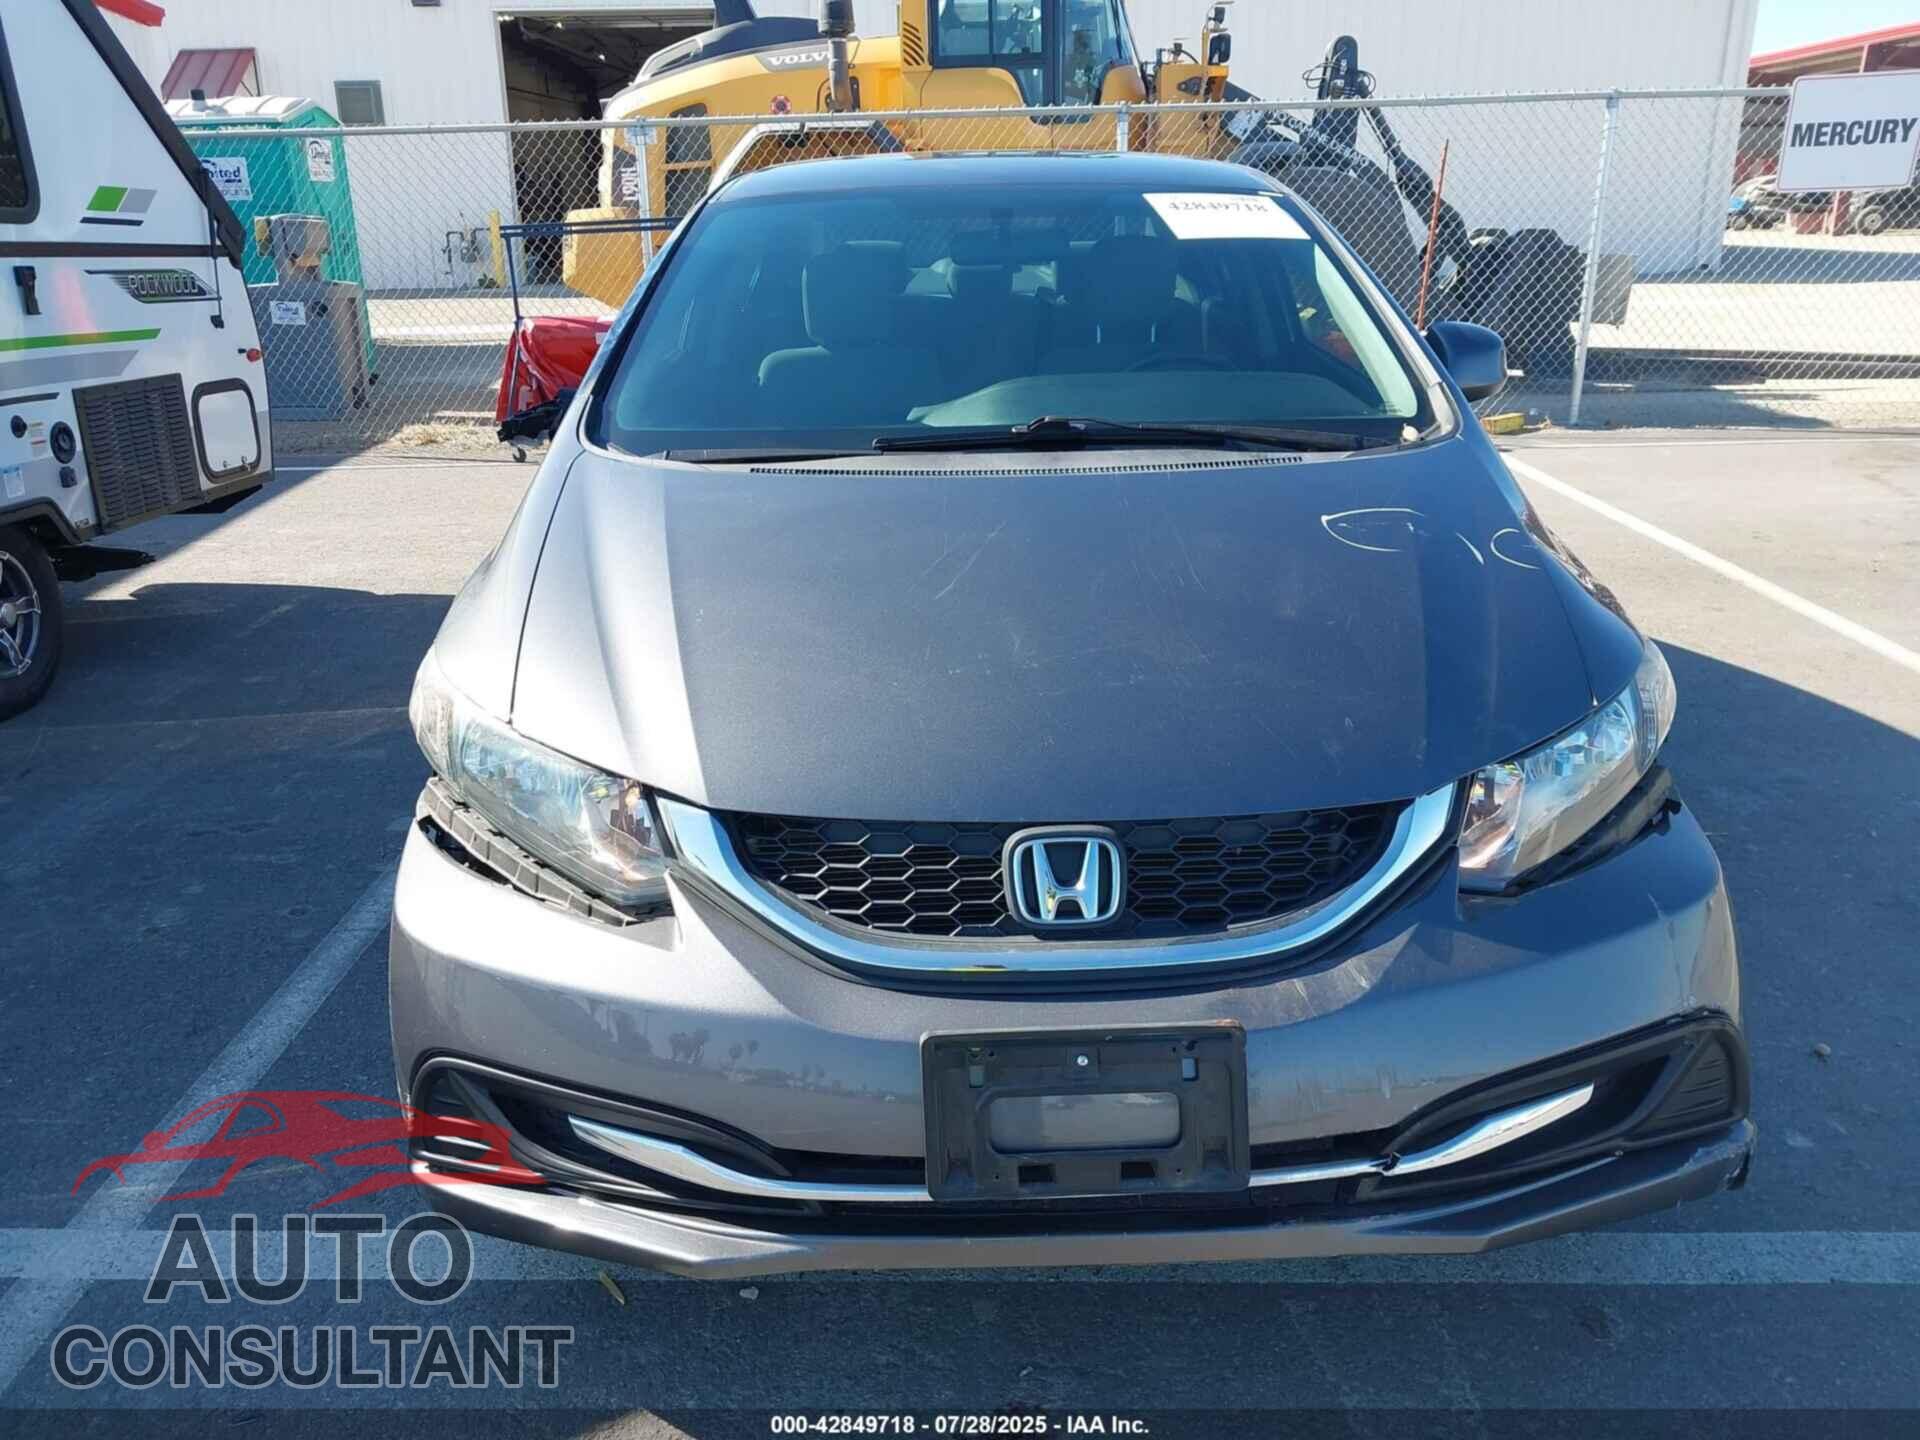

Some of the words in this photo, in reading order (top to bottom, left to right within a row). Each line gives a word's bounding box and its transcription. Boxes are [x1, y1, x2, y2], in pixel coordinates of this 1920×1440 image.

[768, 51, 833, 66] VOLV
[1790, 117, 1919, 148] MERCURY
[127, 273, 199, 295] ROCKWOOD
